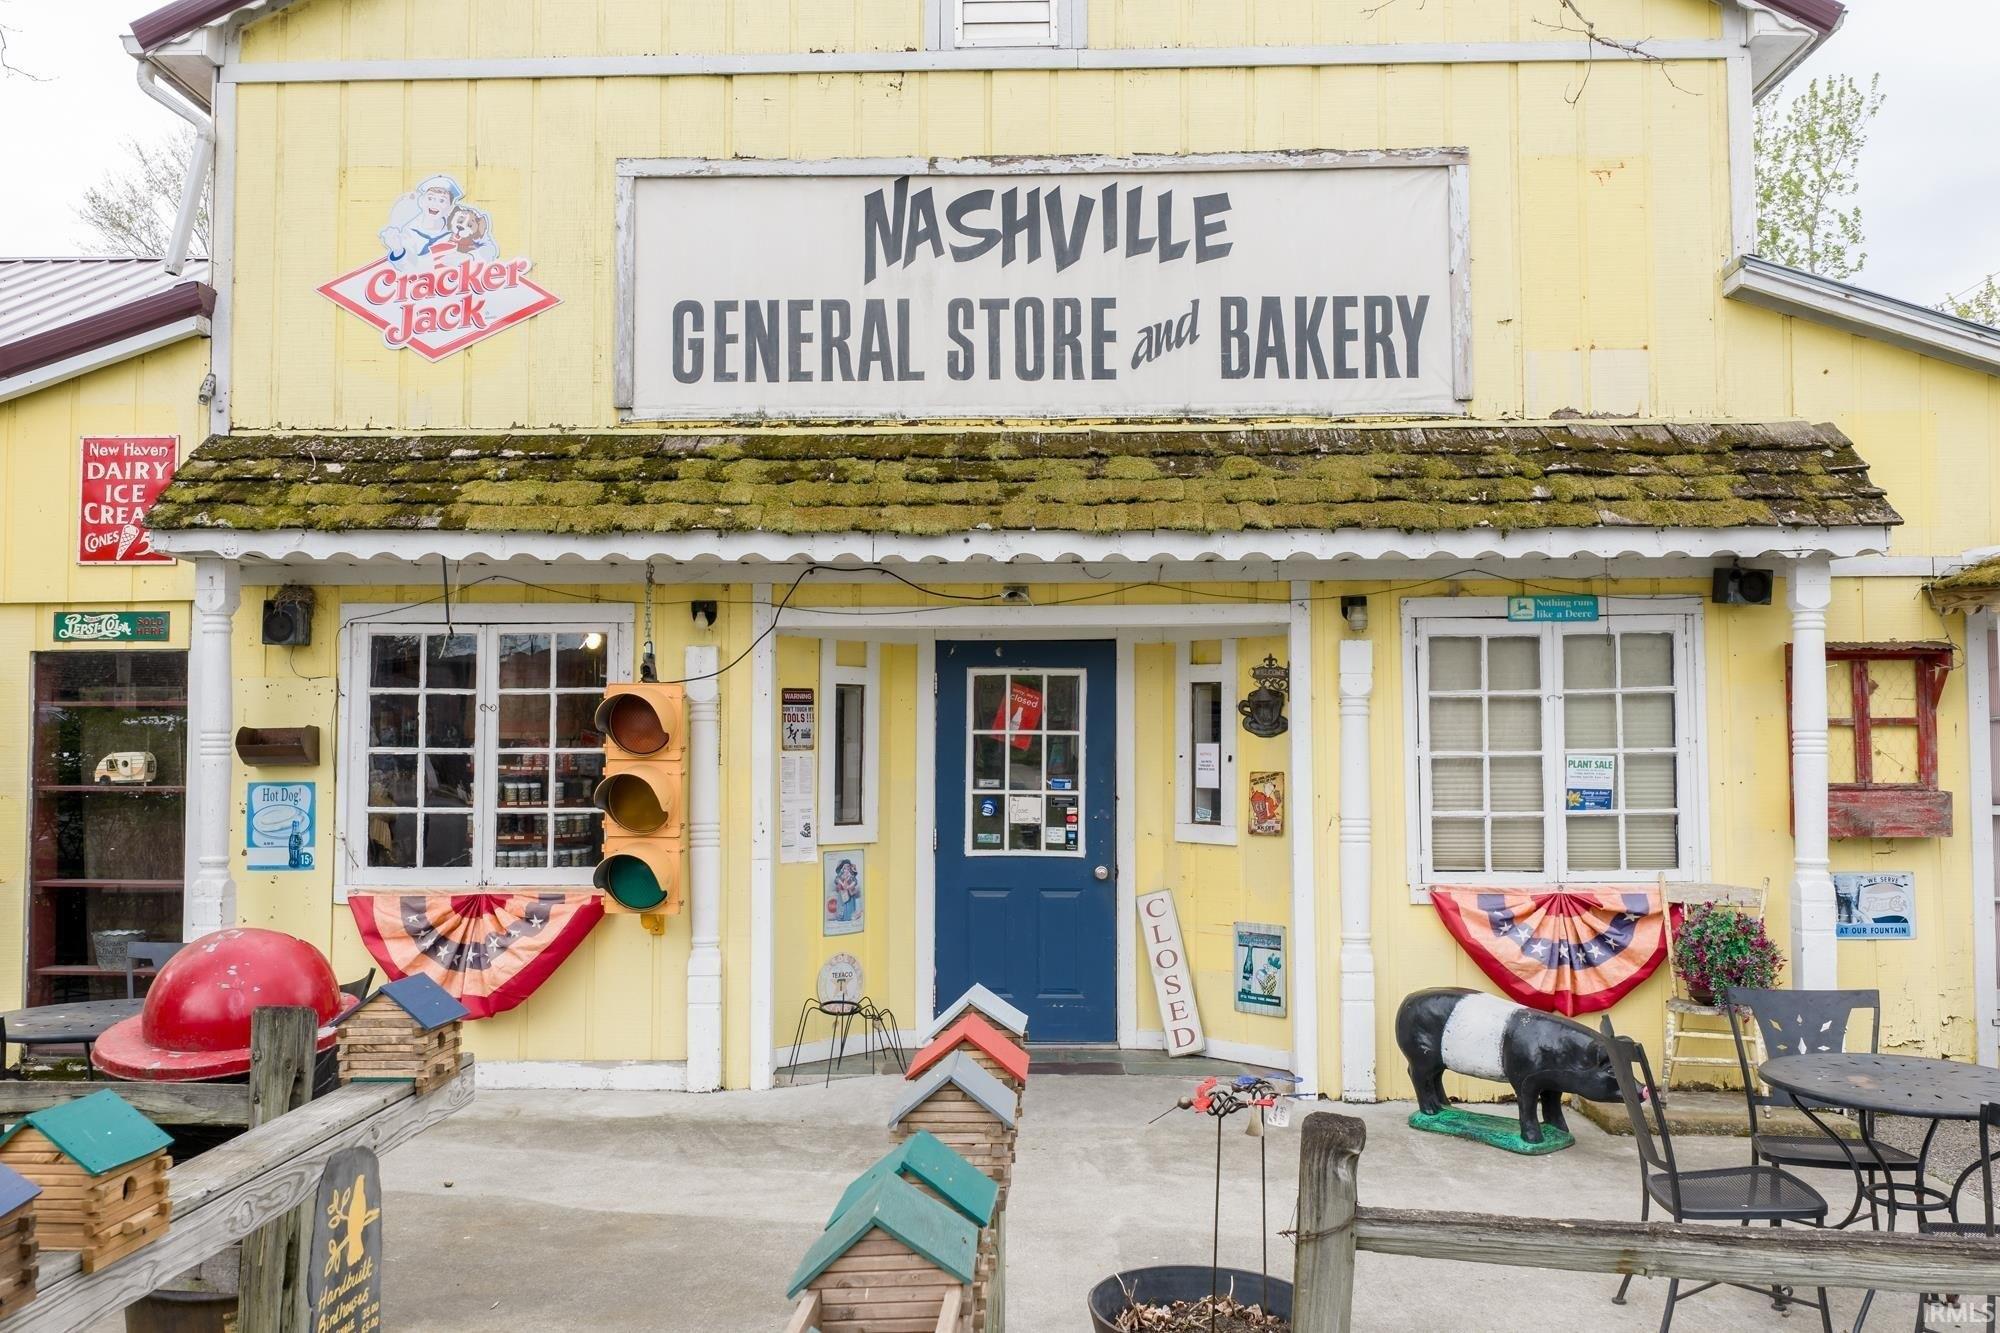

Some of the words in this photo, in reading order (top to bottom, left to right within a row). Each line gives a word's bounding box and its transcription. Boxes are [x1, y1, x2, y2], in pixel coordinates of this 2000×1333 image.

[864, 175, 1233, 285] NASHVILLE
[365, 257, 527, 305] Cracker
[384, 294, 488, 345] Jack
[672, 298, 925, 384] GENERAL
[946, 296, 1117, 381] STORE
[1131, 298, 1200, 370] and
[1220, 295, 1430, 380] BAKERY
[89, 443, 119, 457] New
[123, 443, 169, 457] Haven
[87, 462, 169, 480] DAIRY
[105, 484, 146, 504] ICE
[84, 503, 151, 525] CREA
[1537, 599, 1571, 608] Nothing
[1536, 610, 1553, 618] like
[1565, 610, 1593, 618] Deere
[1568, 760, 1592, 769] PLANT
[1594, 760, 1613, 769] SALE
[262, 788, 279, 802] Hot
[281, 786, 302, 806] Dog!
[1880, 876, 1899, 884] SERVE
[1870, 927, 1907, 935] FOUNTAIN
[832, 971, 853, 979] TEXACO
[1146, 898, 1196, 1049] CLOSED
